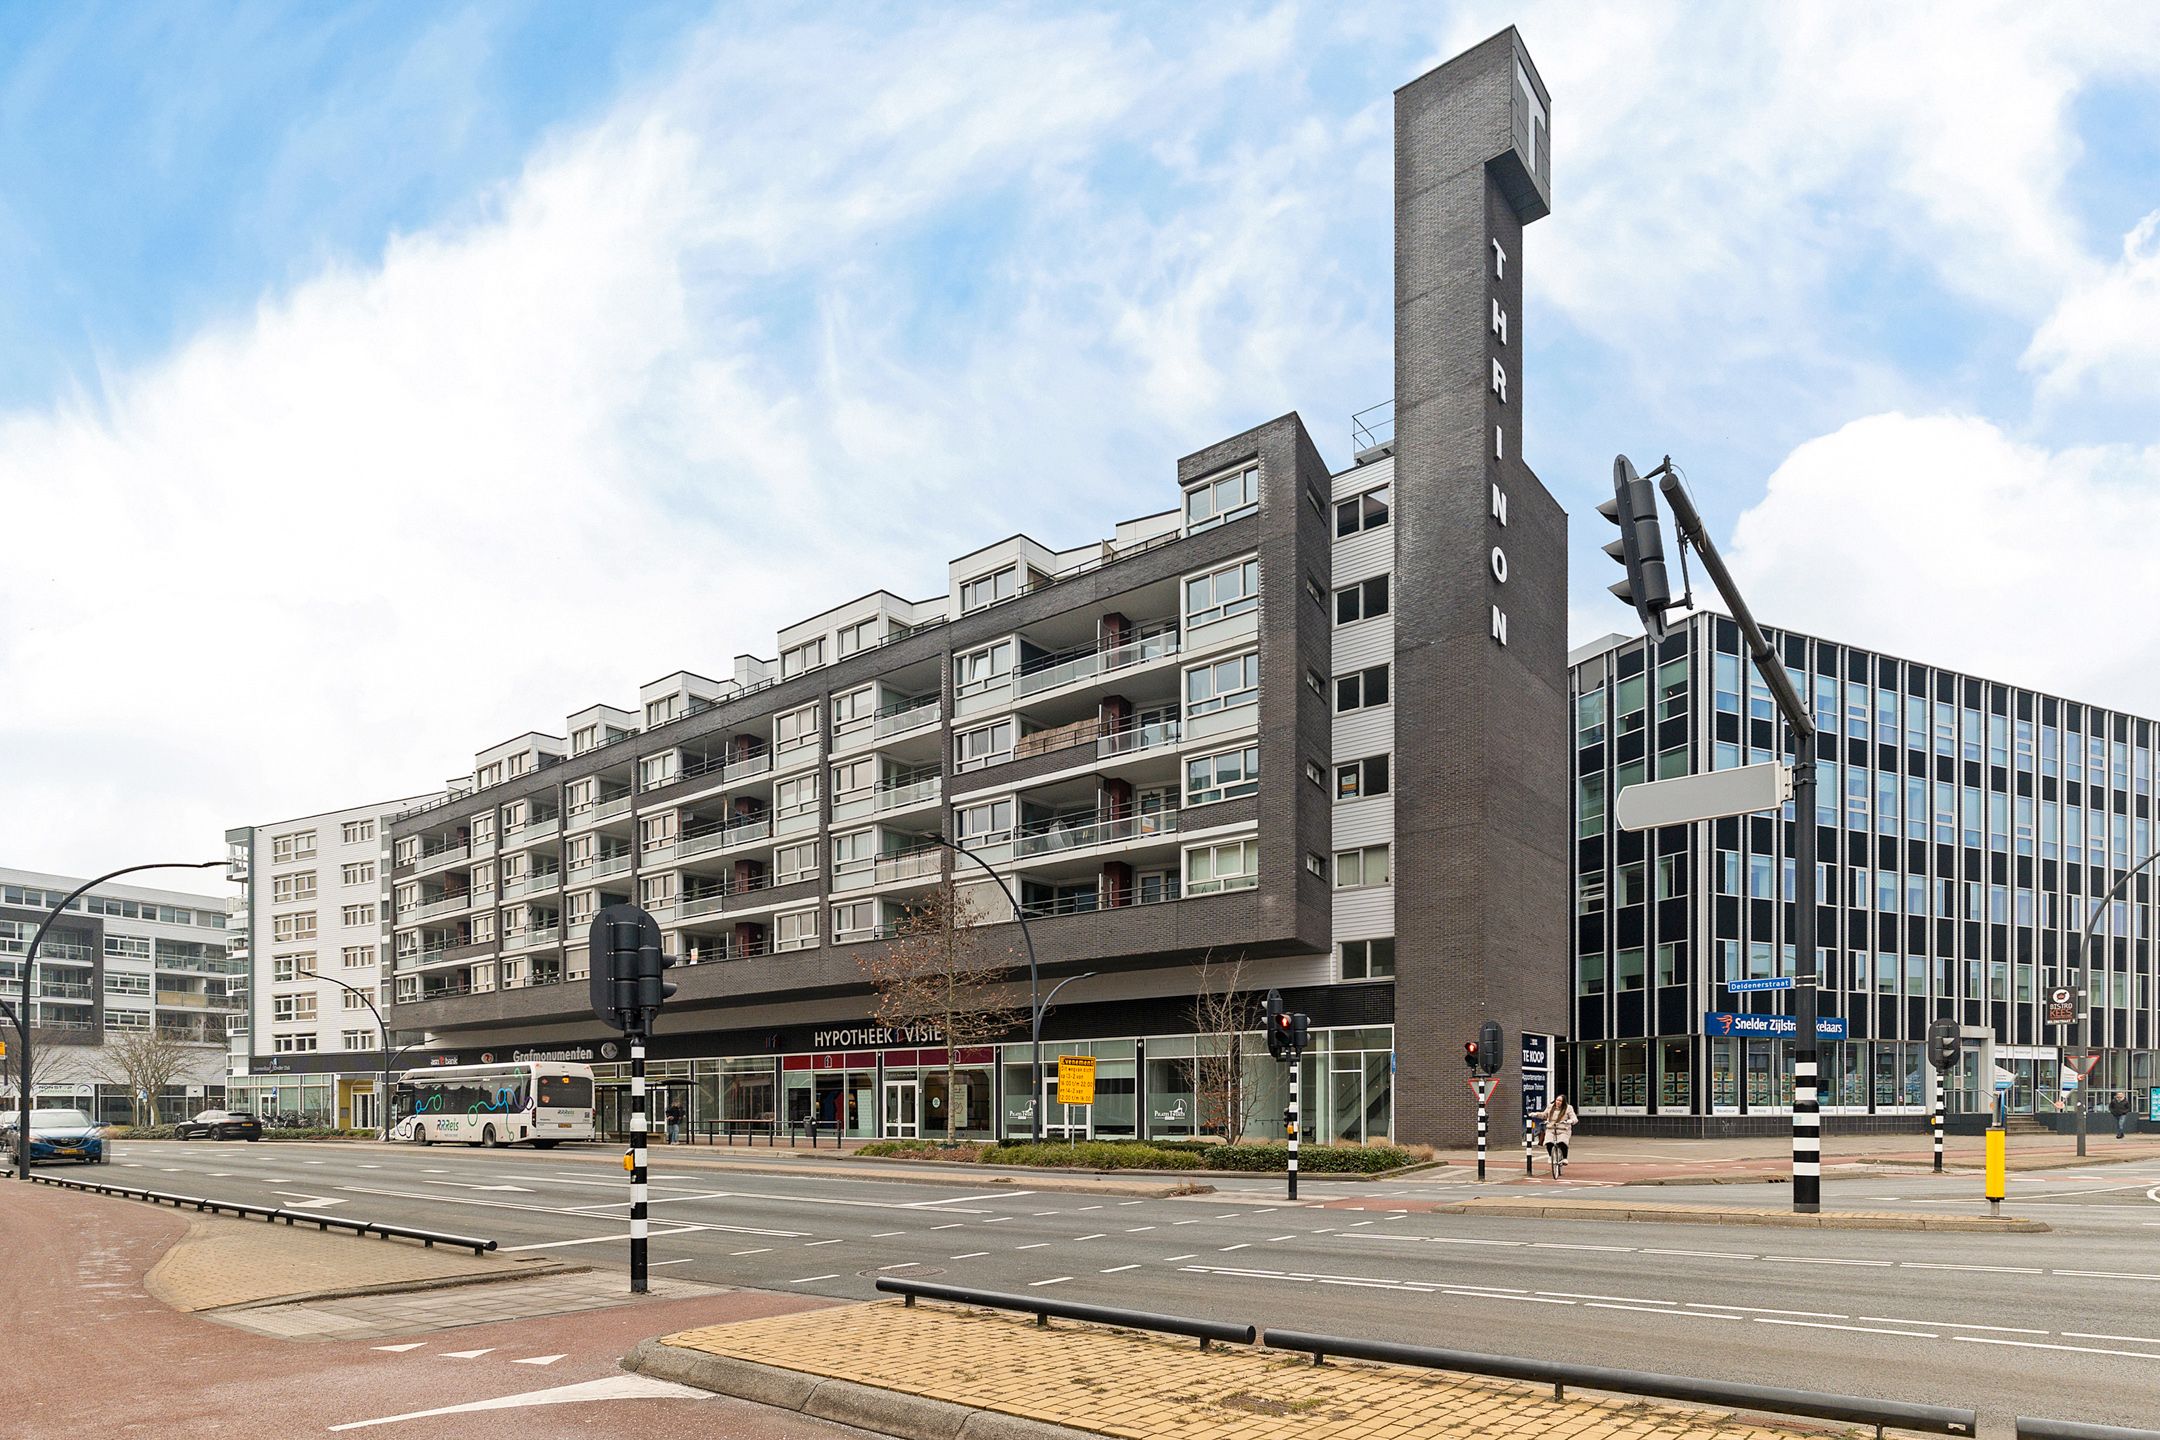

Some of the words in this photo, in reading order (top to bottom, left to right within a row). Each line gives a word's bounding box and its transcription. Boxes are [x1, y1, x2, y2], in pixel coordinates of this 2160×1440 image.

[1490, 238, 1508, 648] THRINON
[1731, 980, 1789, 990] Deldenerstraat
[2049, 1008, 2073, 1017] KEES
[1735, 1017, 1768, 1031] Snelder
[1816, 1020, 1843, 1033] kelaars
[814, 1027, 893, 1047] HYPOTHEEK
[904, 1025, 942, 1043] VISIE
[445, 1056, 458, 1065] bank
[512, 1046, 594, 1062] Grafmonumenten
[1522, 1049, 1529, 1062] TE
[1529, 1050, 1545, 1064] KOOP
[436, 1119, 459, 1131] RRReis
